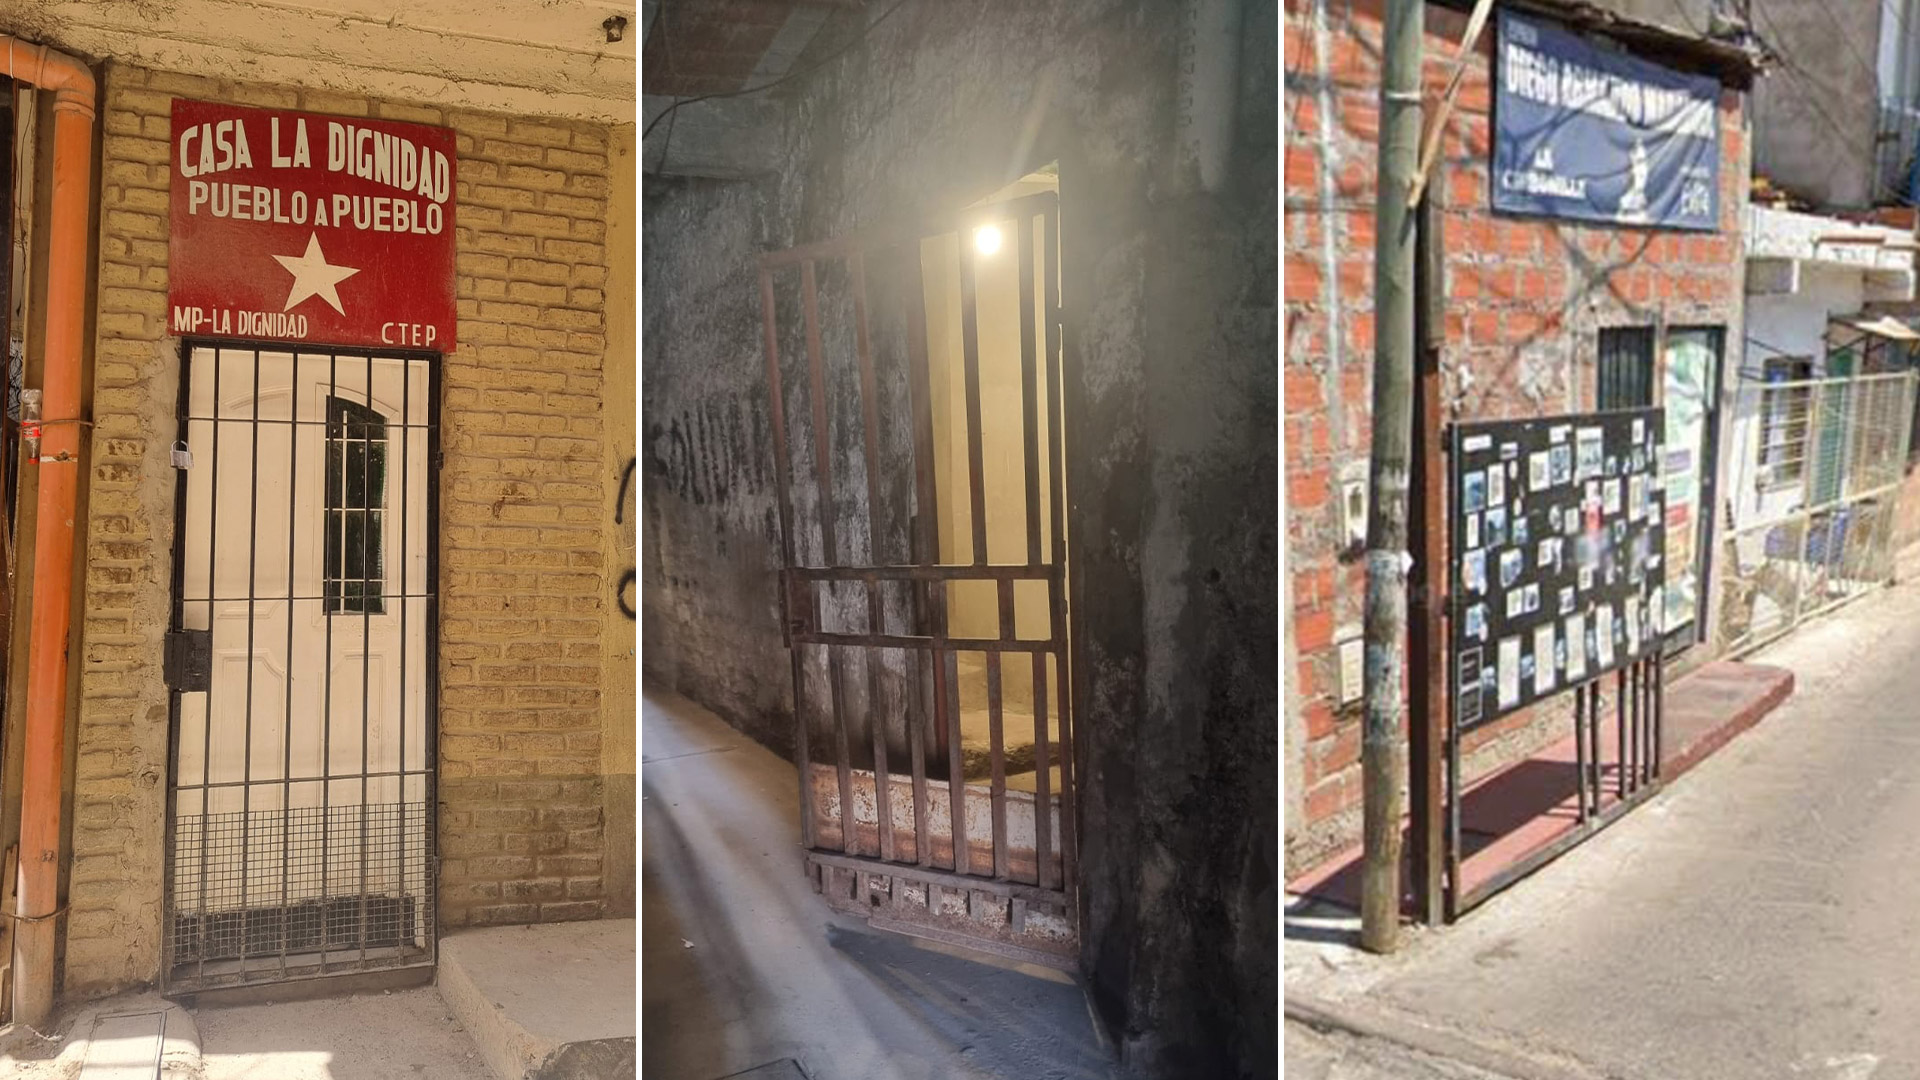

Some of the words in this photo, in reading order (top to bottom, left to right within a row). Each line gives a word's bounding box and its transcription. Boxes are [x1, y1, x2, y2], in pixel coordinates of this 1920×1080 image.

[179, 119, 253, 178] CASA
[271, 117, 311, 168] LA
[328, 121, 450, 204] DIGNIDAD
[189, 180, 308, 225] PUEBLO
[314, 198, 329, 227] A
[332, 194, 443, 235] PUEBLO
[237, 310, 308, 339] DIGNIDAD
[381, 322, 436, 347] CTEP
